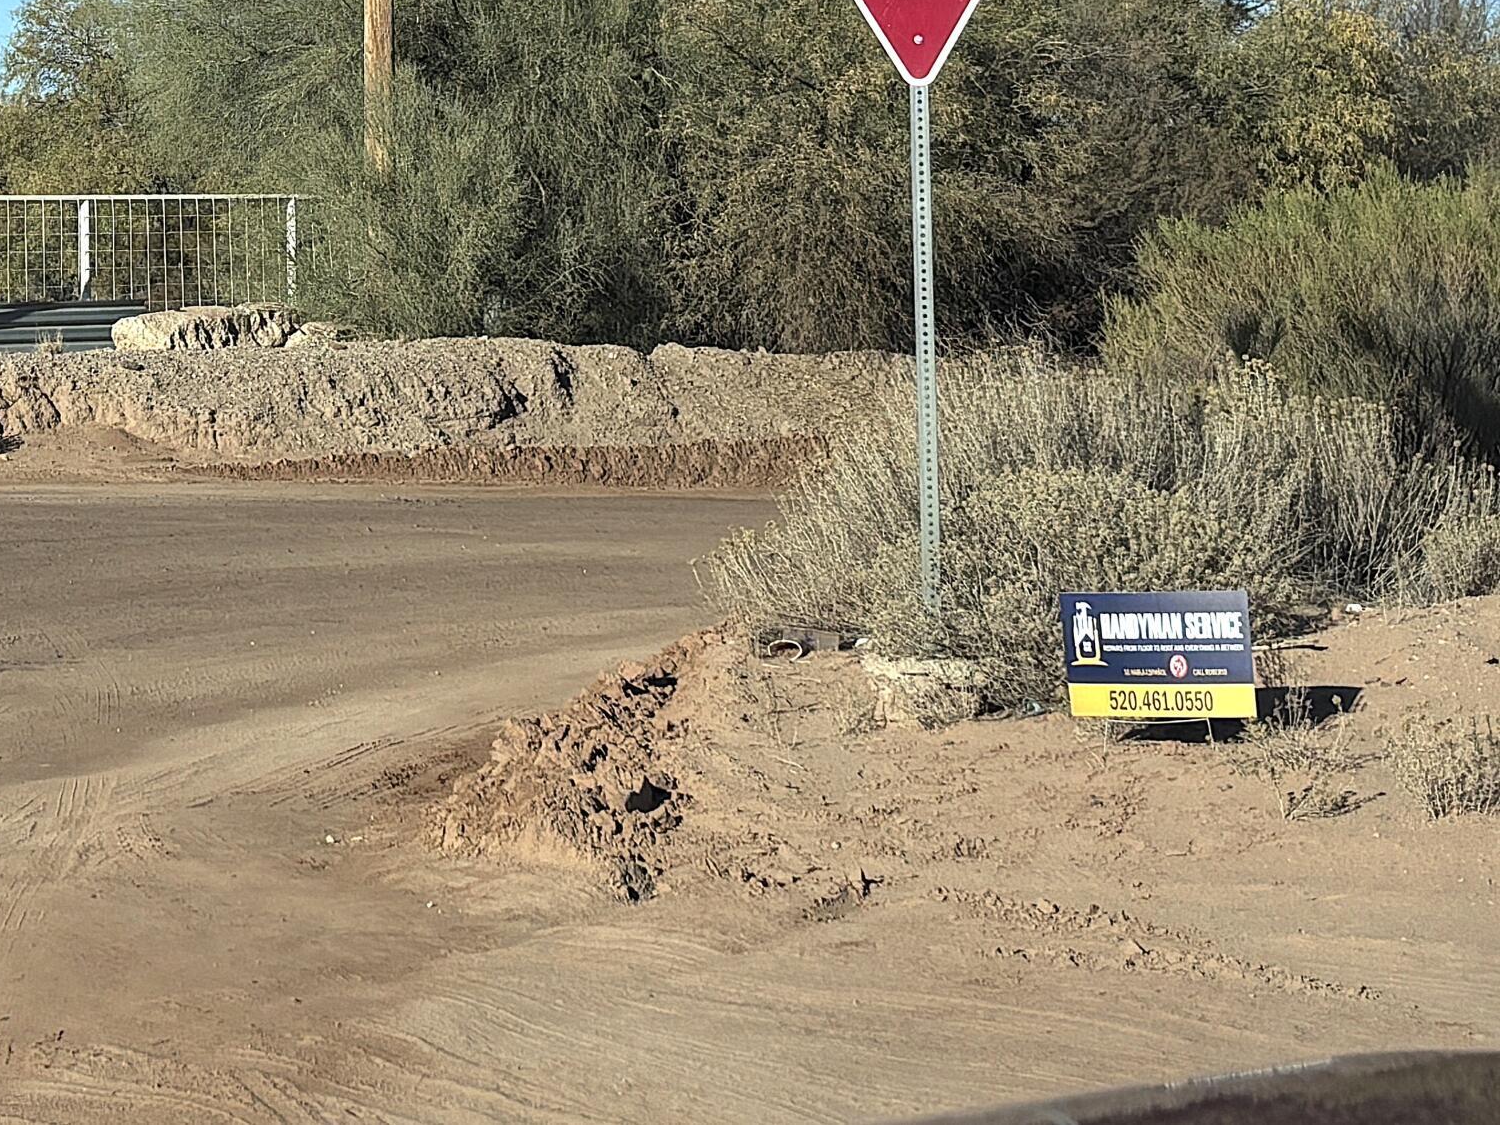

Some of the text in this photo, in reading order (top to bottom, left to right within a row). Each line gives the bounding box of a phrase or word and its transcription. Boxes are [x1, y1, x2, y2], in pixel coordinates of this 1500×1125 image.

[1100, 611, 1244, 640] HANDYMAN SERVICE
[1109, 690, 1213, 711] 520.461.0550
